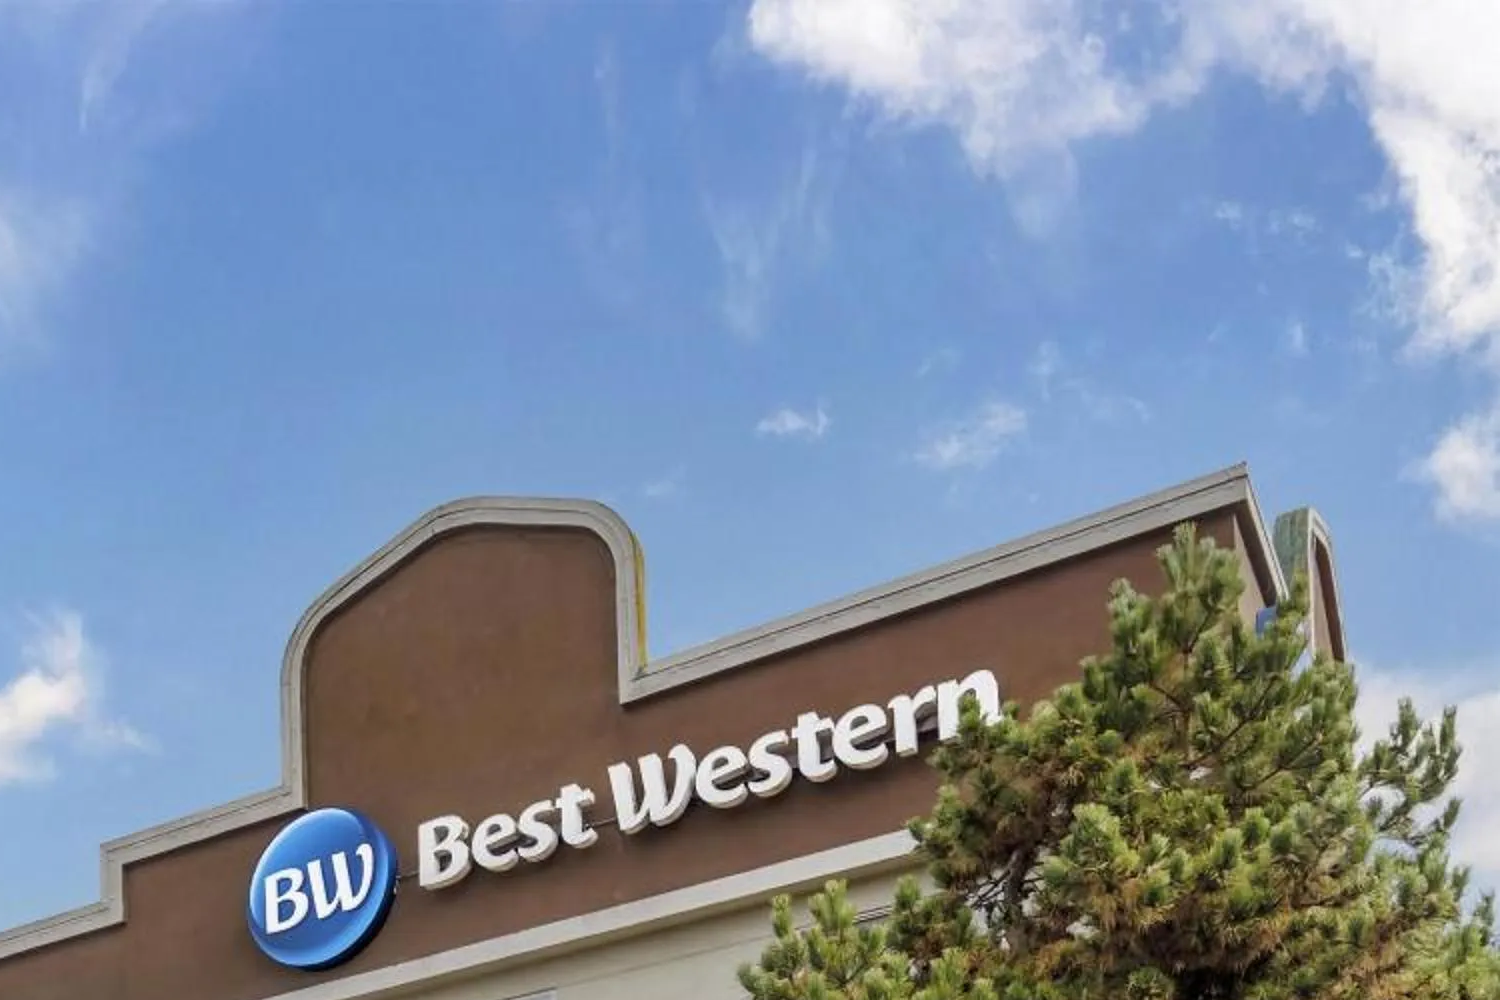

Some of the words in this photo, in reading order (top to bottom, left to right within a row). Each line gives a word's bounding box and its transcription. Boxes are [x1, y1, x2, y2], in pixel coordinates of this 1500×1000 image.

[418, 785, 598, 890] Best
[608, 669, 1002, 835] Western
[264, 843, 373, 935] BW
